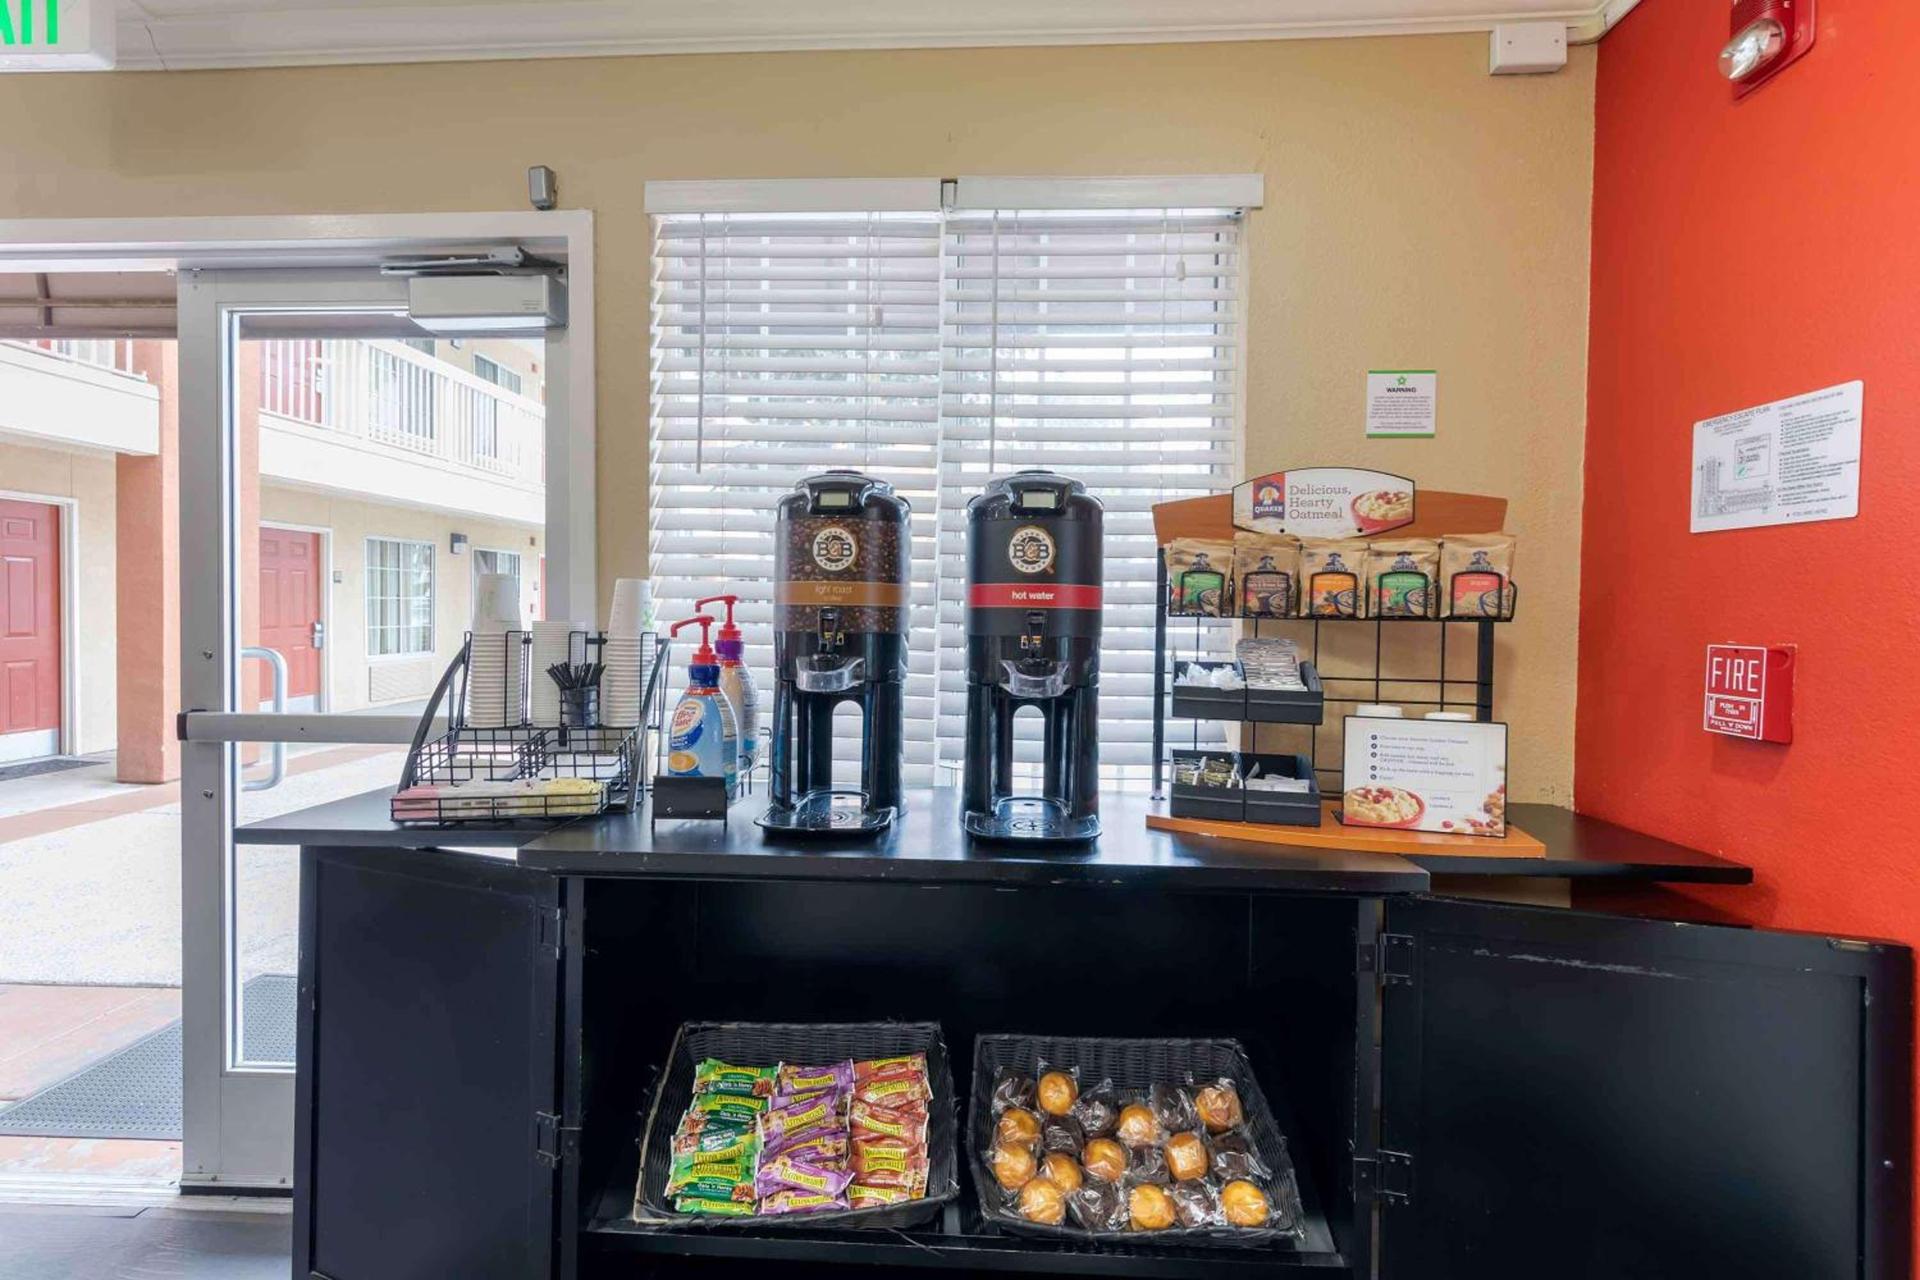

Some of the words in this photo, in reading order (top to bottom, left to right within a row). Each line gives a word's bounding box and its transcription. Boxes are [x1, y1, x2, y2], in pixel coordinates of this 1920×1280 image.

[1289, 484, 1352, 496] Delicious,
[1289, 497, 1334, 508] Hearty
[1254, 505, 1283, 514] QUAKER
[1289, 507, 1343, 520] Oatmeal
[1012, 591, 1028, 600] hot
[1029, 592, 1055, 600] water
[1711, 657, 1760, 692] FIRE
[1710, 719, 1726, 727] PULL
[1735, 723, 1753, 731] DOWN
